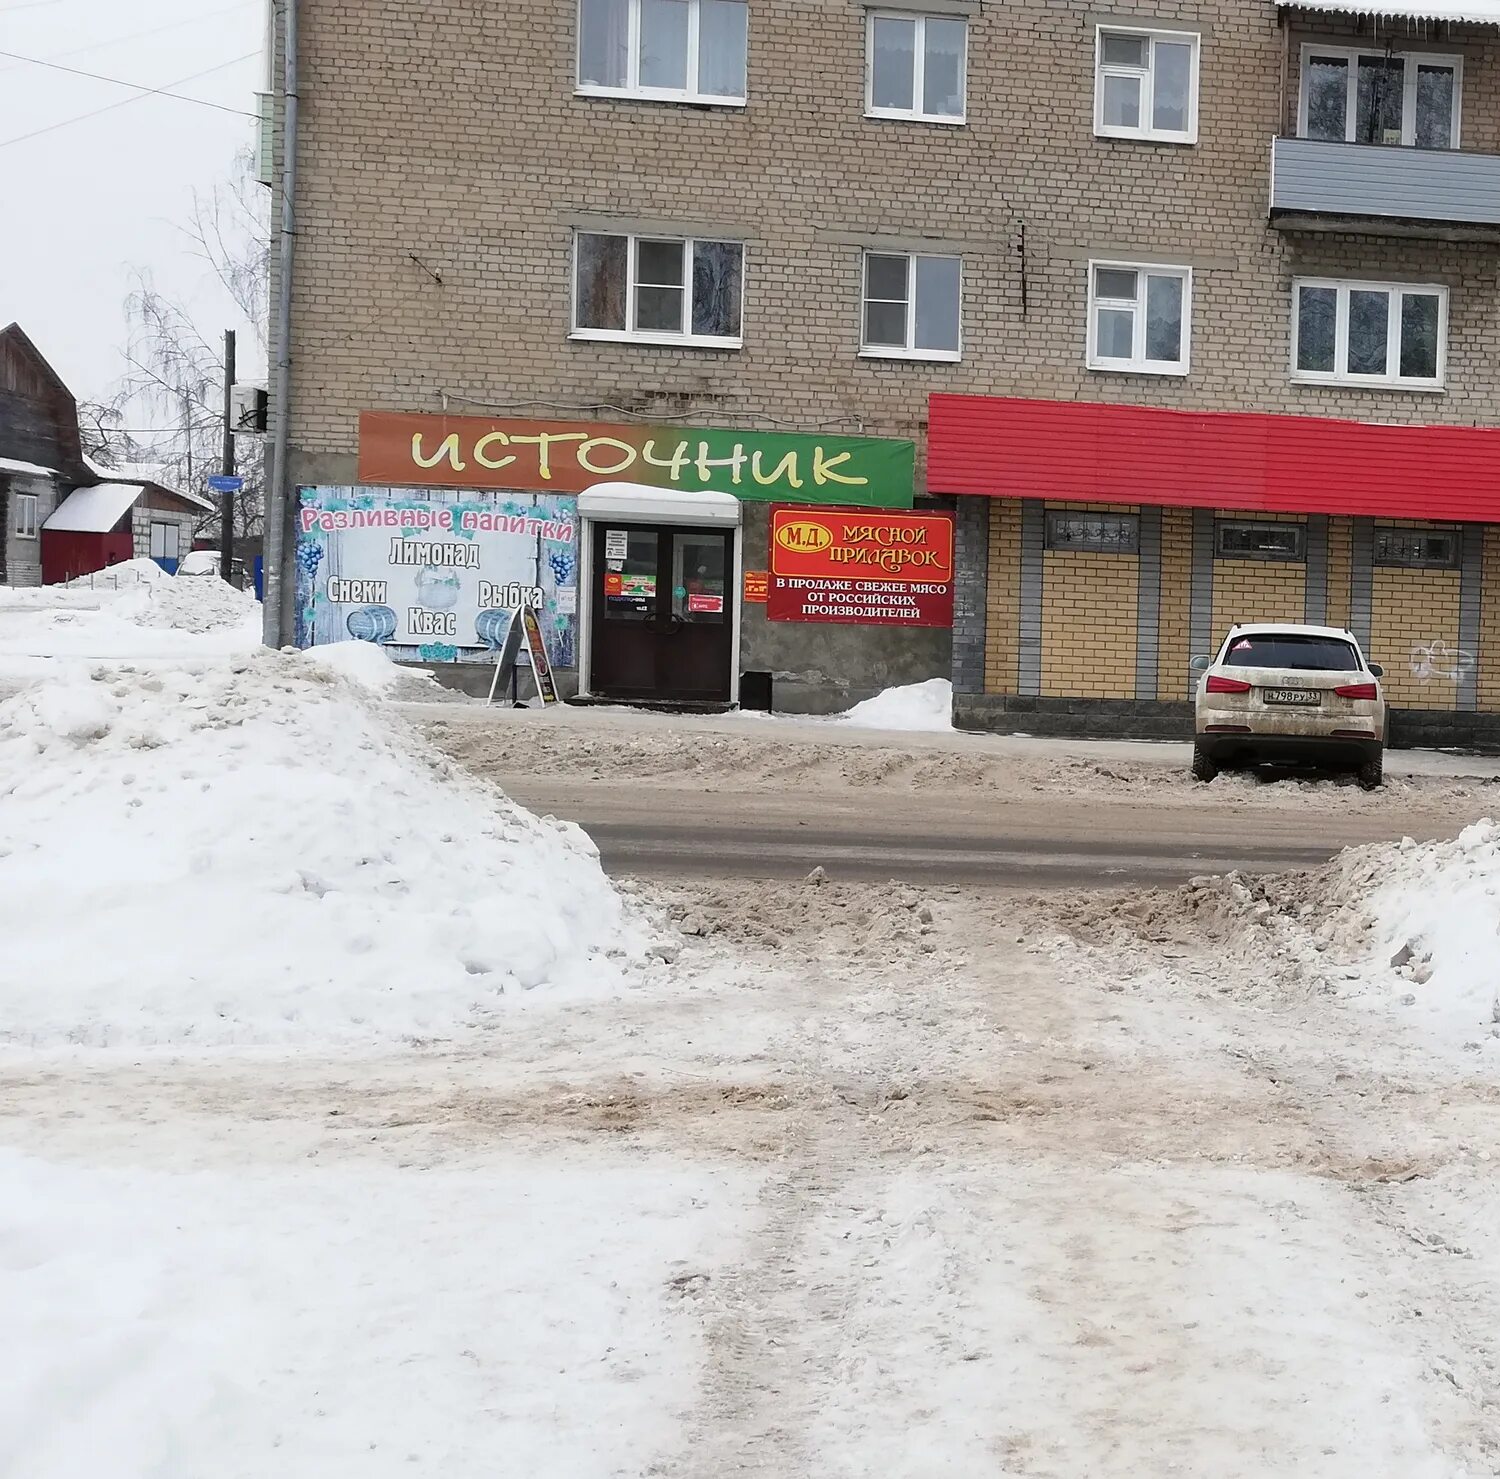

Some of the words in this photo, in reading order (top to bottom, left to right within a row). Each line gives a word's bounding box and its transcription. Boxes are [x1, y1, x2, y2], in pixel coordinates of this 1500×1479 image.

[301, 507, 453, 532] Разливные
[461, 511, 574, 542] напитки
[786, 527, 823, 547] М.Д.
[842, 525, 927, 546] МЯСНОЙ
[388, 537, 480, 569] Лимонад
[829, 547, 949, 573] ПРИЛАВОК
[326, 576, 387, 604] Снеки
[478, 581, 544, 610] Рыбка
[776, 579, 785, 588] В
[789, 579, 852, 591] ПРОДАЖЕ
[855, 582, 906, 592] СВЕЖЕЕ
[910, 584, 947, 594] МЯСО
[808, 592, 825, 602] ОТ
[829, 593, 916, 605] РОССИЙСКИХ
[407, 607, 456, 635] Квас
[802, 605, 920, 618] ПРОИЗВОДИТЕЛЕЙ
